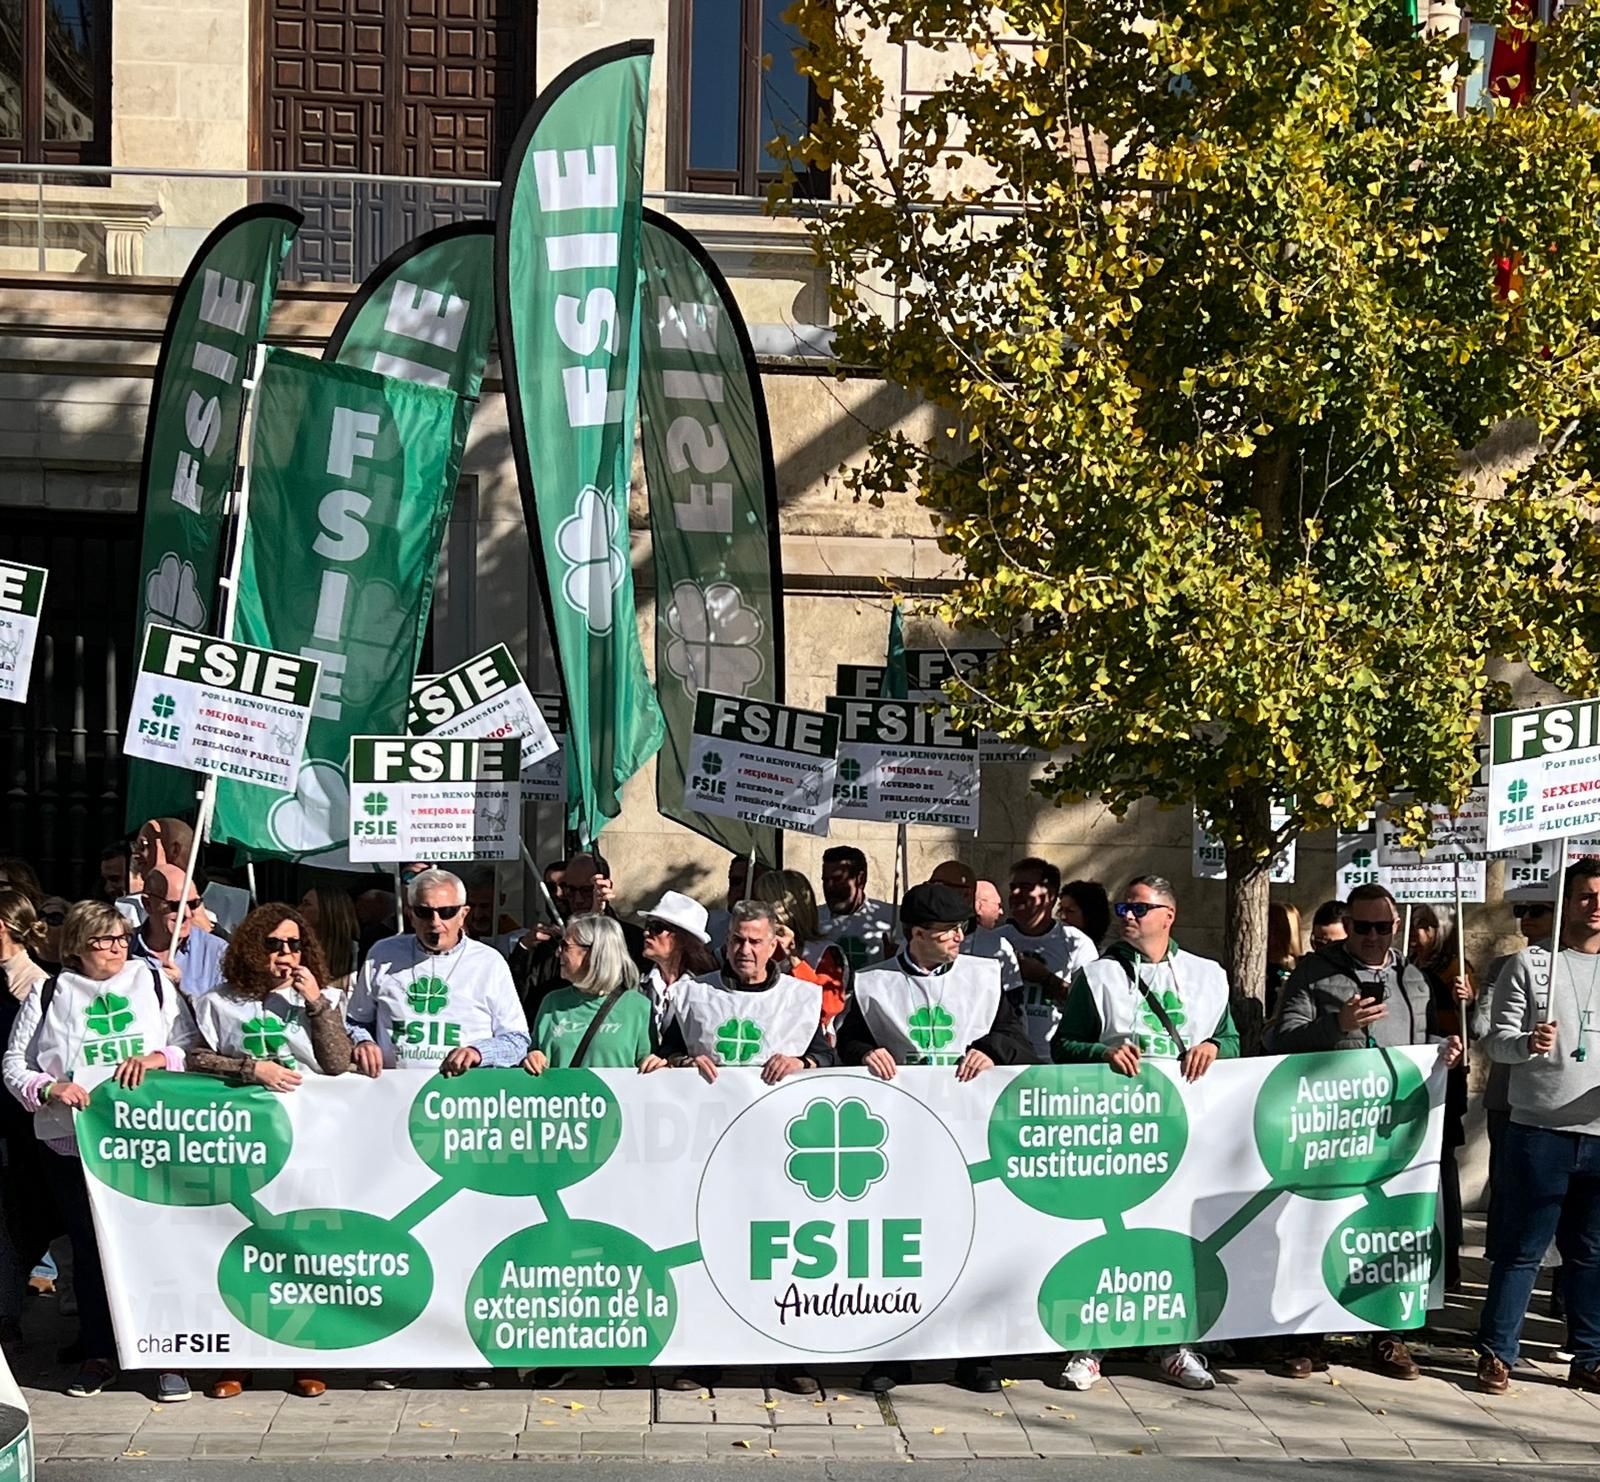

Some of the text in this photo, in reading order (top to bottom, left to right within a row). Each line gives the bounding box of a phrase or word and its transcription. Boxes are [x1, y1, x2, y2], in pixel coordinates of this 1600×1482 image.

[533, 145, 624, 427] FSIE
[171, 269, 256, 514] FSIE
[300, 406, 380, 721] FSIE
[163, 634, 300, 701] FSIE
[206, 709, 248, 725] MEJORA
[235, 697, 304, 719] RENOVACIÓN
[461, 700, 510, 729] nuestros
[138, 718, 181, 741] FSIE
[195, 723, 241, 739] ACUERDO
[711, 698, 823, 754] FSIE
[846, 702, 962, 746] FSIE
[1511, 705, 1600, 760] FSI
[192, 738, 291, 766] JUBILACIÓN PARCIAL
[374, 741, 504, 781] FSIE
[910, 750, 974, 762] RENOVACIÓN
[1545, 754, 1600, 770] Por nues
[194, 757, 288, 786] #LUCHAFSIE!!
[744, 768, 779, 781] MEJORA
[887, 766, 926, 776] MEJORA
[411, 792, 429, 800] POR
[442, 789, 509, 799] RENOVACIÓN
[692, 776, 727, 795] FSIE
[736, 782, 773, 794] ACUERDO
[833, 784, 868, 799] FSIE
[881, 781, 921, 790] ACUERDO
[418, 808, 459, 816] MEJORA
[932, 798, 970, 807] PARCIAL
[1499, 805, 1534, 826] FSIE
[354, 821, 397, 836] FSIE
[737, 811, 814, 832] #LUCHAFSIE!!
[885, 811, 970, 825] #LUCHAFSIE!!
[1539, 812, 1600, 831] #LUCHAF
[415, 851, 504, 860] #LUCHAFSIE!!
[1199, 847, 1225, 860] FSIE
[1344, 872, 1379, 884] FSIE
[1512, 868, 1550, 881] FSIE
[1395, 890, 1476, 899] #LUCHAFSE!!
[391, 1020, 461, 1047] FSIE
[1139, 1034, 1190, 1056] FSI
[83, 1038, 144, 1066] FSIE
[1019, 1085, 1161, 1117] Eliminación
[1297, 1070, 1390, 1104] Acuerdo
[114, 1101, 251, 1132] Reducción
[424, 1089, 607, 1127] Complemento
[1288, 1099, 1393, 1143] jubilación
[444, 1121, 588, 1160] para el PAS
[1018, 1117, 1159, 1148] carencia en
[99, 1133, 267, 1168] carga lectiva
[1007, 1147, 1168, 1178] sustituciones
[1303, 1128, 1375, 1171] parcial
[243, 1245, 410, 1277] Por nuestros
[750, 1218, 922, 1280] FSIE
[500, 1260, 643, 1295] Aumento y
[1096, 1266, 1172, 1295] Abono
[269, 1279, 383, 1306] sexenios
[473, 1288, 668, 1320] extensión de la
[774, 1282, 922, 1325] Andalucía
[1399, 1291, 1415, 1321] y
[1080, 1293, 1186, 1324] de la PEA
[137, 1333, 231, 1354] chaFSIE
[495, 1319, 647, 1350] Orientación
